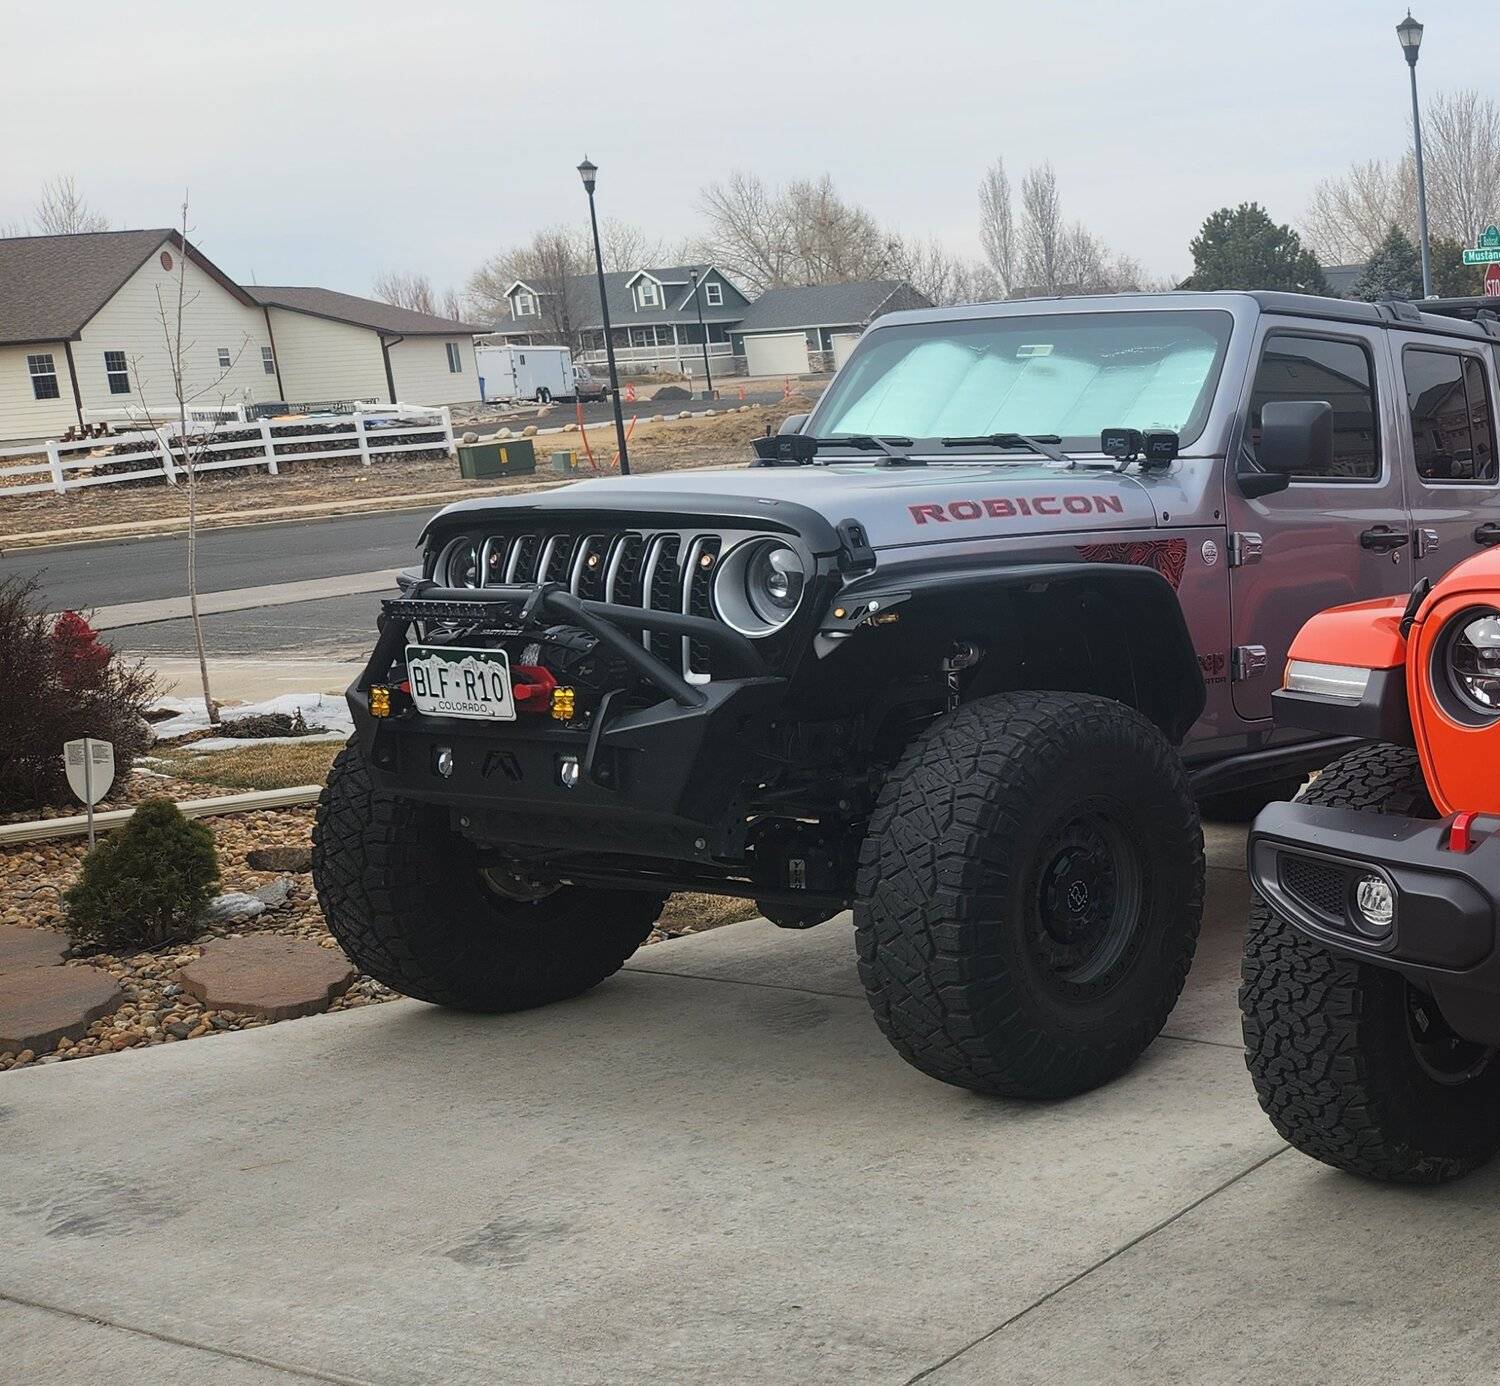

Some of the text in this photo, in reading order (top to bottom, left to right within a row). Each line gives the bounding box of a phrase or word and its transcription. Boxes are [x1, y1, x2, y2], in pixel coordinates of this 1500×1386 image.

[1152, 442, 1172, 451] RC
[907, 496, 1124, 525] ROBICON
[438, 700, 488, 713] COLORADO
